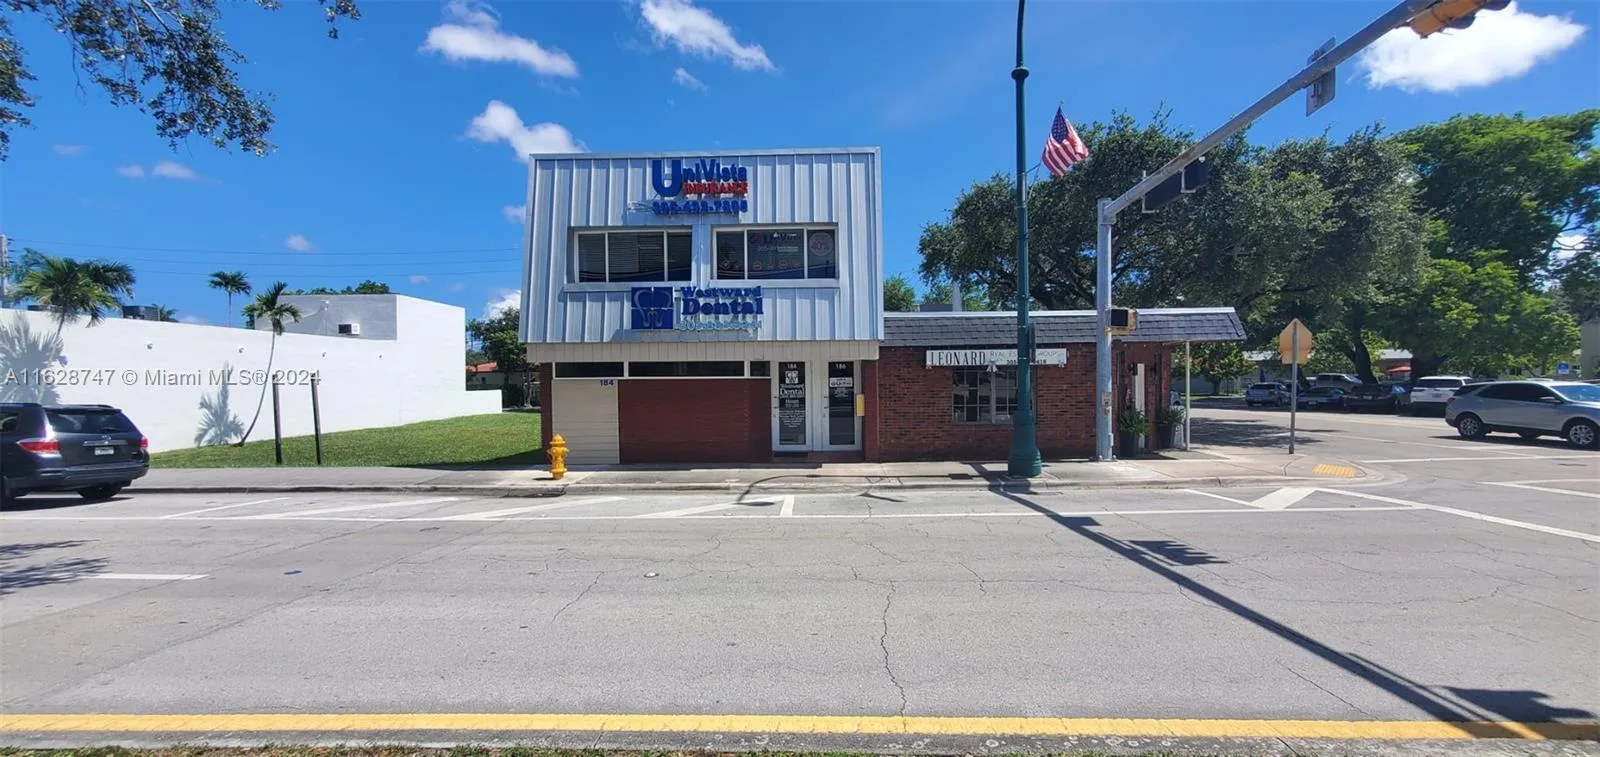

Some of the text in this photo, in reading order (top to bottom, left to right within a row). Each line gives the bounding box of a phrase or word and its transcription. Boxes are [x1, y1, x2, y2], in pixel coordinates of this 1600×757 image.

[652, 159, 748, 197] UniVista
[683, 182, 748, 195] INSURANCE
[680, 286, 762, 298] Westward
[682, 297, 763, 315] Dental
[929, 352, 986, 365] LEONARD
[600, 379, 614, 387] 184
[780, 388, 804, 396] Dental
